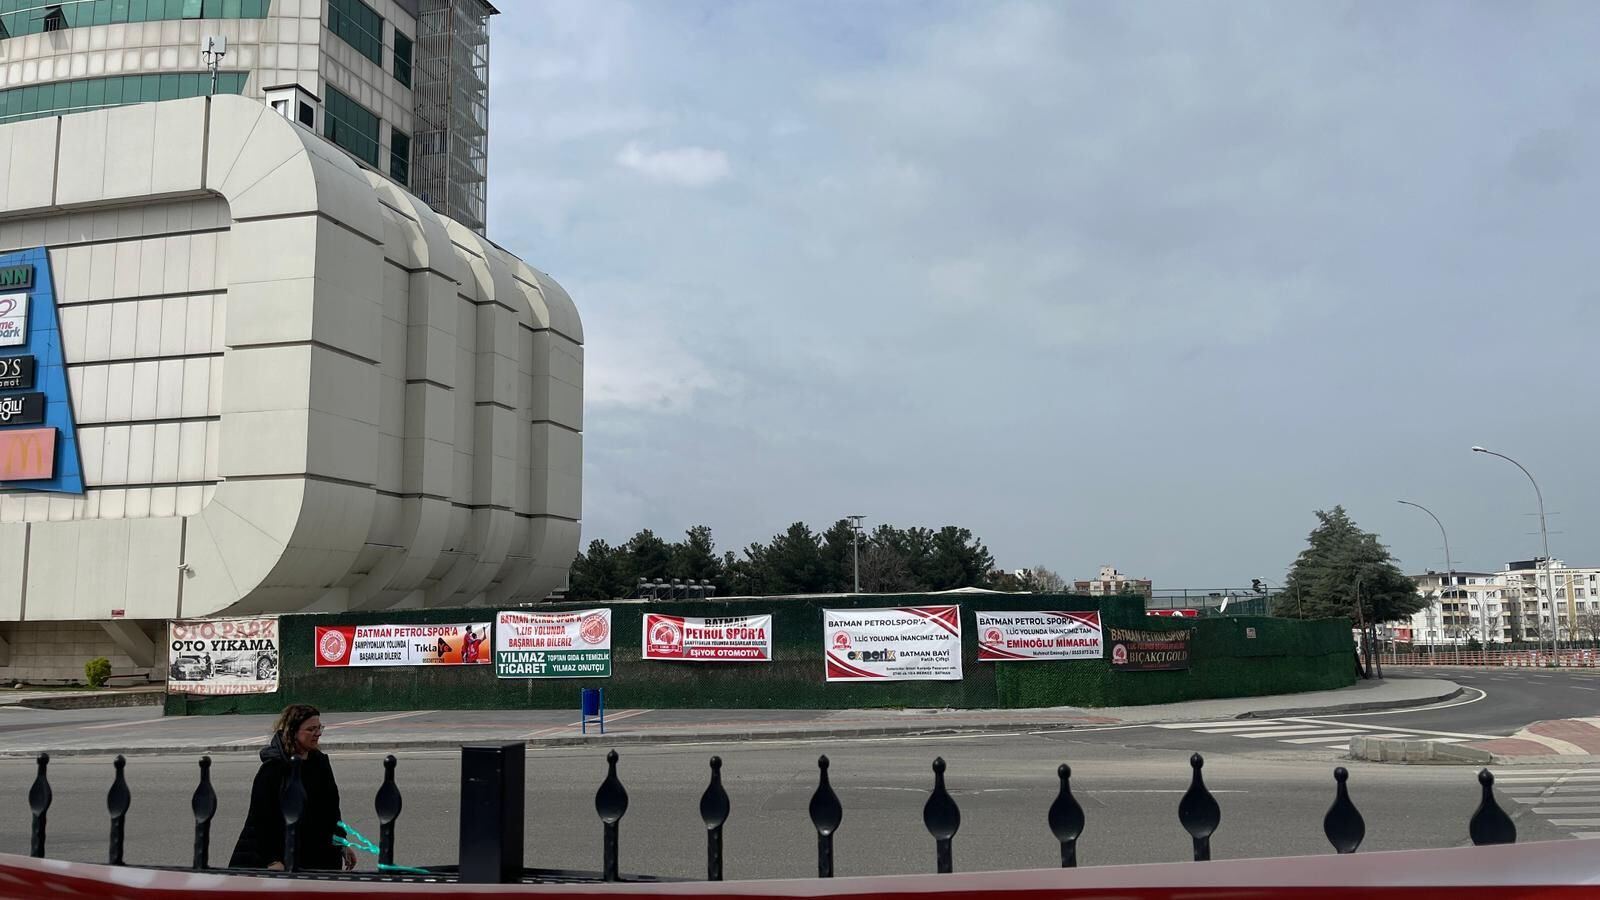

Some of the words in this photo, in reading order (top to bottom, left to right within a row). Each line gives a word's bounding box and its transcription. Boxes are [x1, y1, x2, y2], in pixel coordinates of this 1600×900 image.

[501, 614, 529, 624] BATMAN
[864, 619, 927, 627] PETROLSPOR'A
[979, 617, 1013, 625] BATMAN
[1015, 617, 1045, 625] PETROL
[1047, 617, 1074, 625] SPOR'A
[173, 622, 216, 640] OTO
[357, 629, 392, 638] BATMAN
[394, 627, 458, 637] PETROLSPOR'A
[534, 625, 566, 635] YOLUNDA
[686, 628, 723, 639] PETROL
[726, 627, 765, 639] SPOR'A
[1111, 629, 1140, 641] BATMAN
[172, 640, 205, 651] OTO
[211, 639, 275, 651] YIKAMA
[386, 640, 407, 648] YOLUNDA
[414, 644, 437, 652] Tıkla
[509, 638, 545, 649] BAŞARILAR
[1007, 638, 1054, 648] EMİNOĞLU
[1056, 637, 1099, 647] MİMARLIK
[500, 652, 545, 663] YILMAZ
[847, 648, 896, 661] experix
[1166, 651, 1188, 661] GOLD
[577, 663, 605, 672] ONUTÇU
